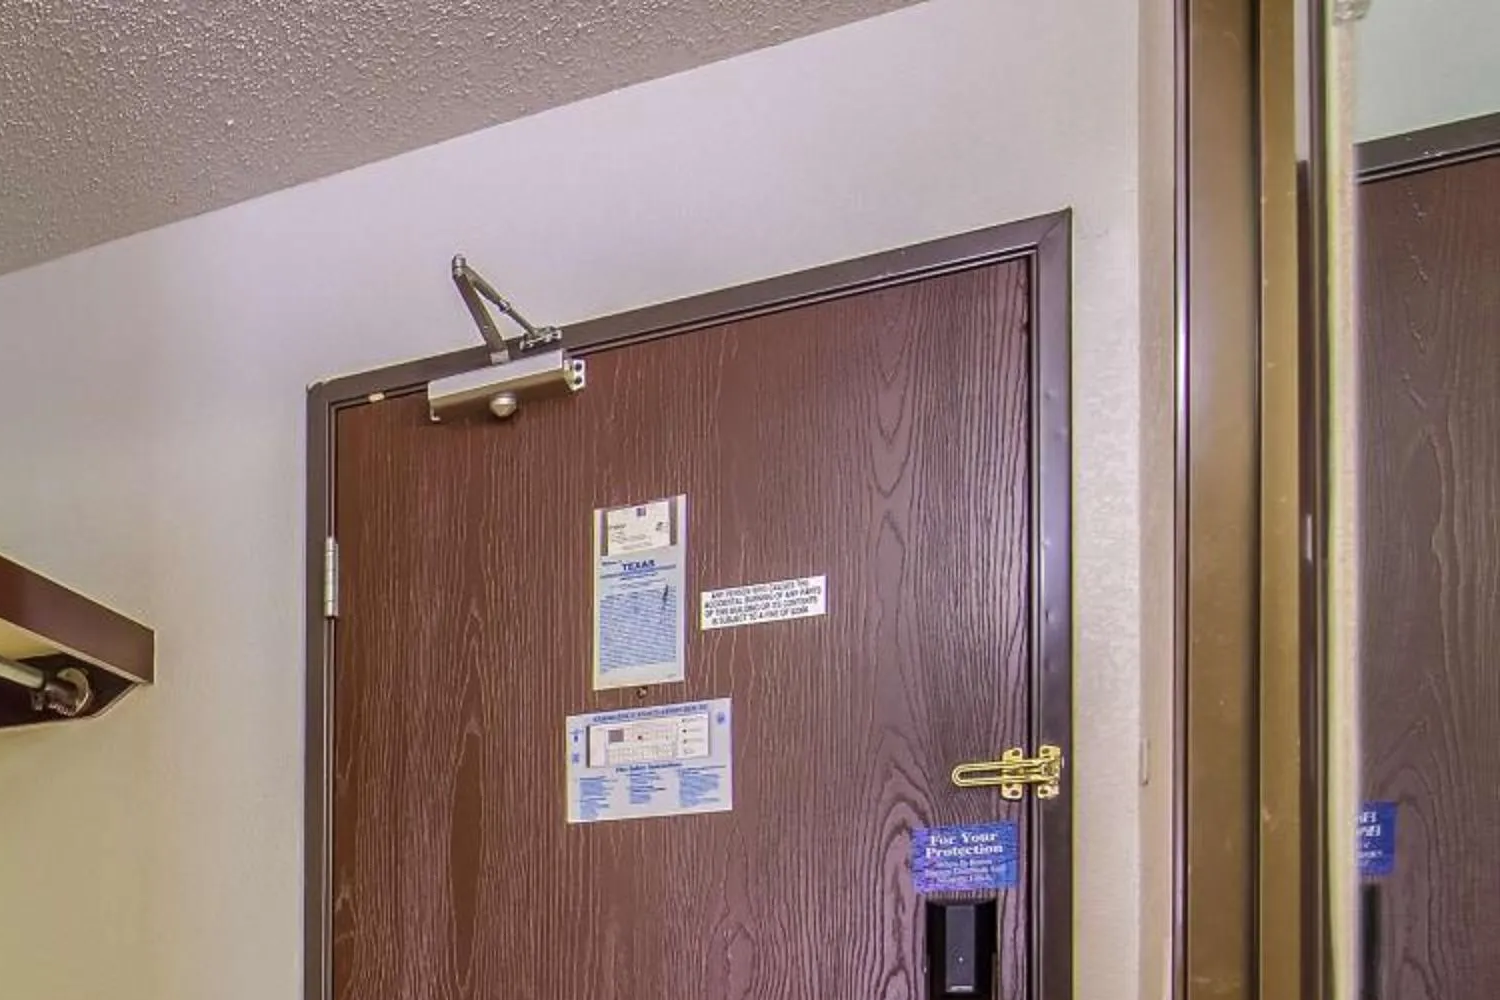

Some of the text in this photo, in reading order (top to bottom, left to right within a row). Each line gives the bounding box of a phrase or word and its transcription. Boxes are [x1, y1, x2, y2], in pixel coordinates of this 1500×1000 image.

[622, 559, 655, 571] TEXAS
[930, 832, 999, 847] For Your
[925, 844, 1004, 859] Protection
